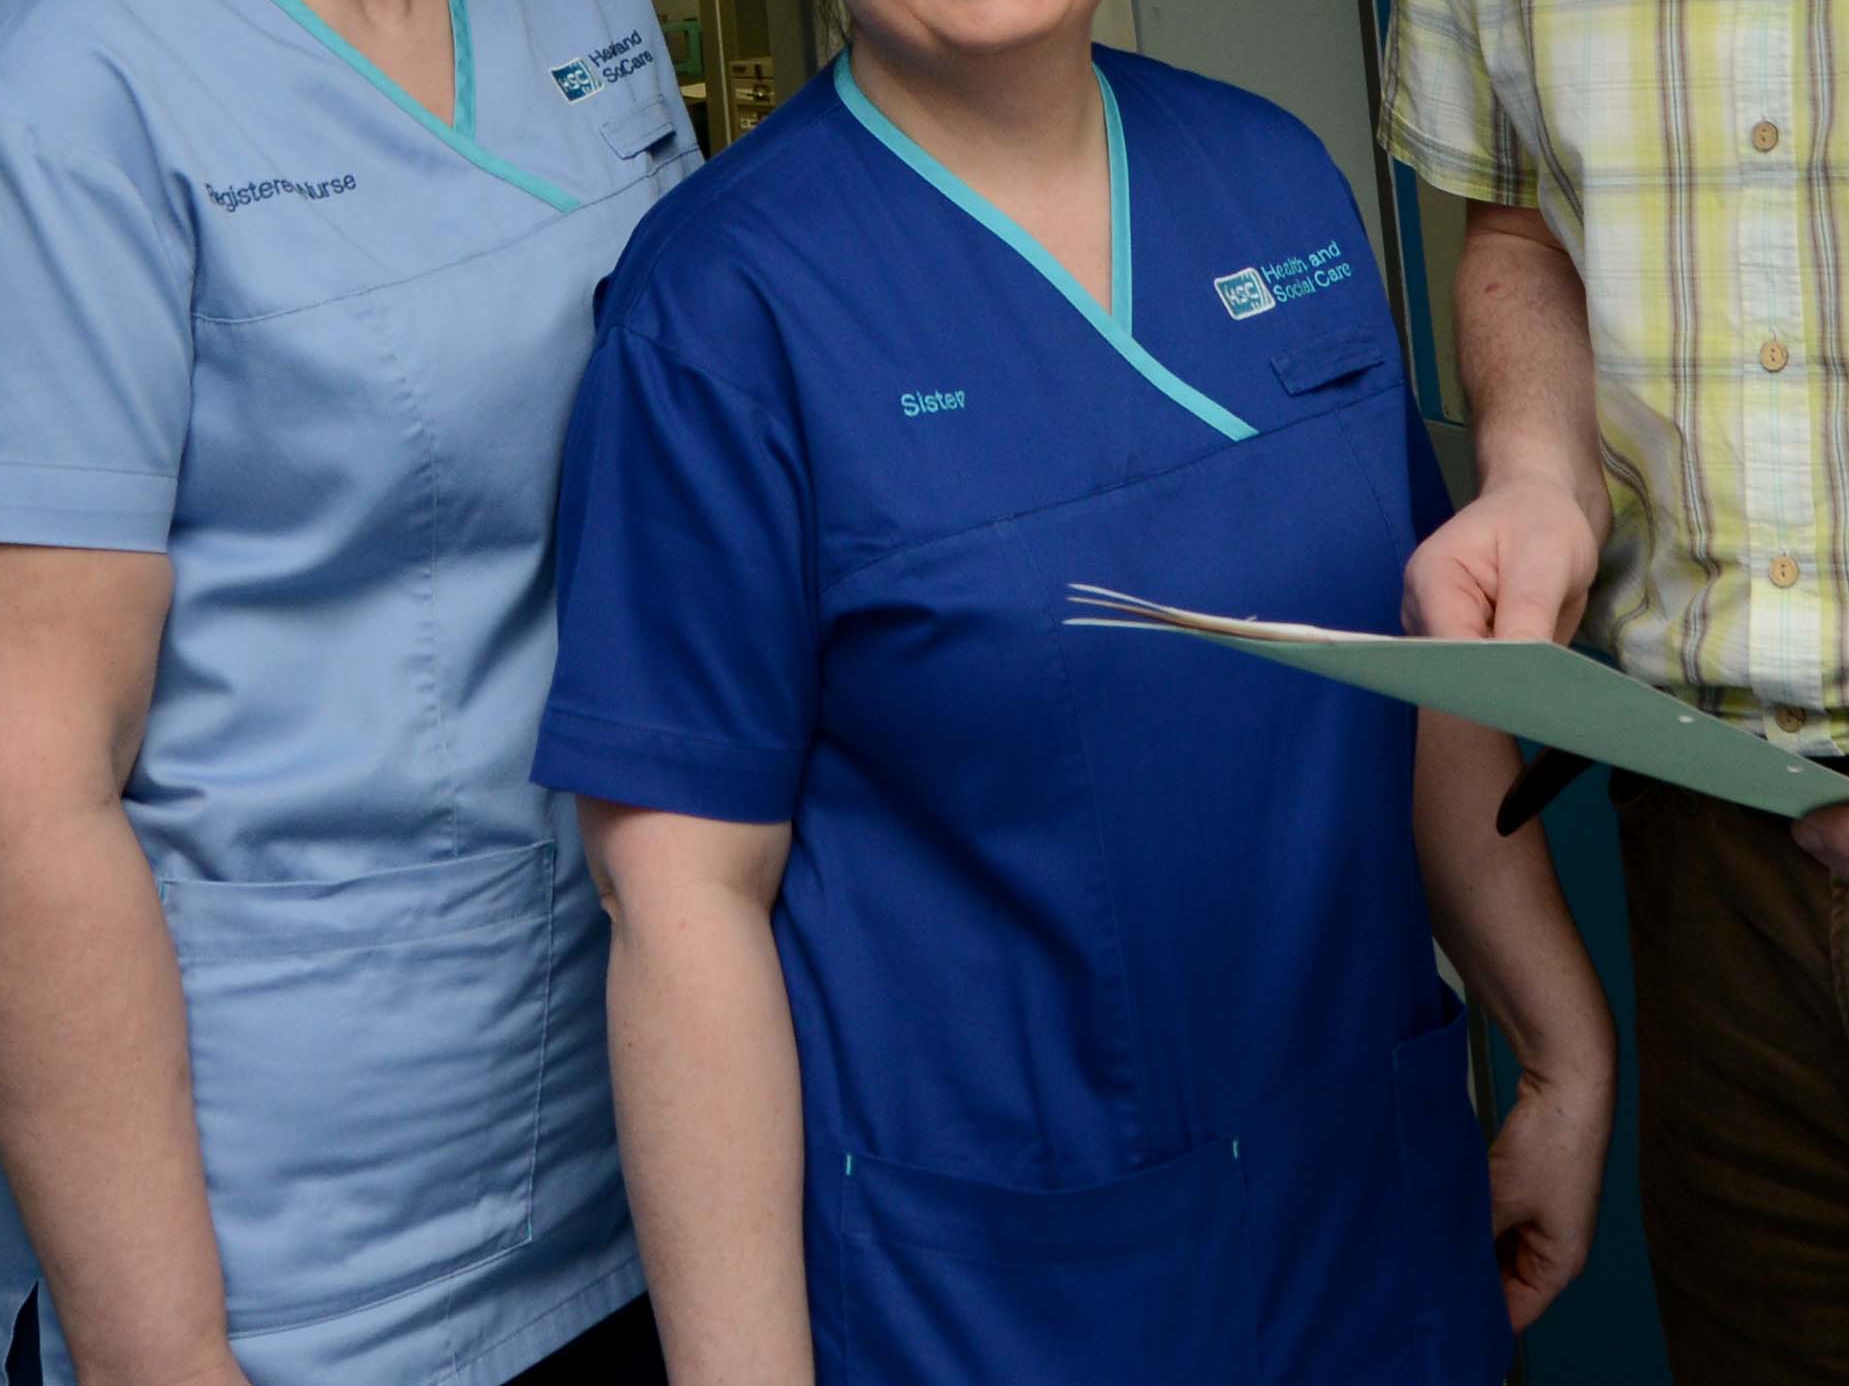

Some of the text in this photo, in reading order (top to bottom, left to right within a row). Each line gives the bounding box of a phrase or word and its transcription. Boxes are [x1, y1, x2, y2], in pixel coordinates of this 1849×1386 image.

[205, 178, 294, 213] Registere
[1260, 240, 1341, 284] Health and
[1224, 280, 1259, 306] HSC
[1274, 263, 1352, 303] Social Care
[901, 389, 965, 417] Sister
